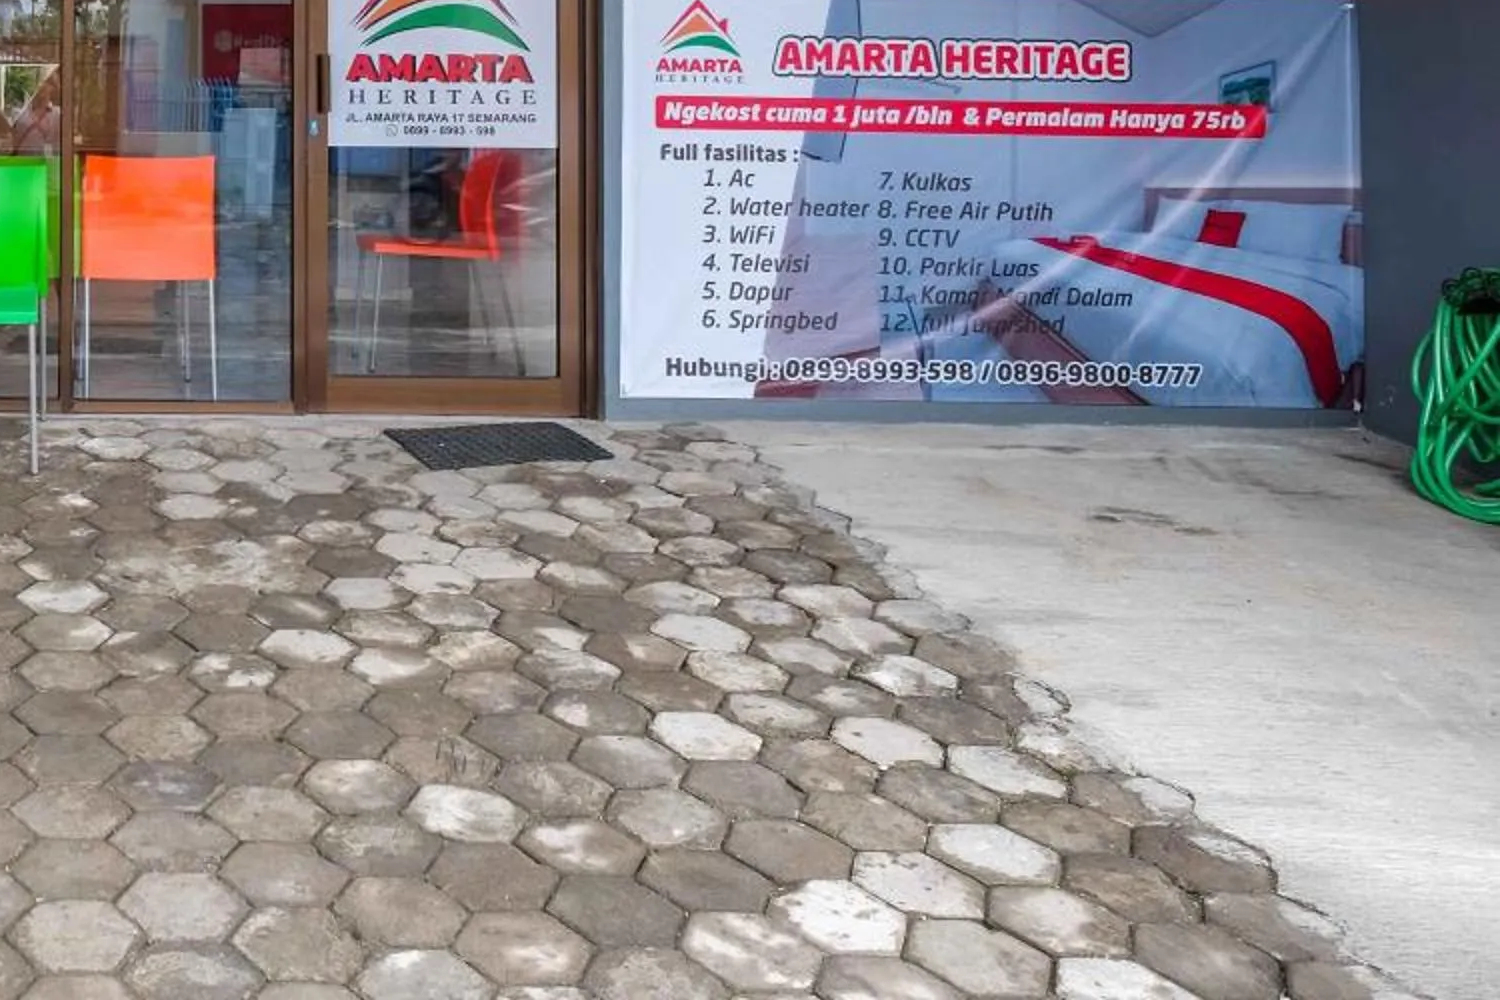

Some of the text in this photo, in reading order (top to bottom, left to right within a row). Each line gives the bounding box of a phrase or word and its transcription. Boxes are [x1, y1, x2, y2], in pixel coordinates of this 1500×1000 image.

[345, 54, 534, 83] AMARTA
[656, 58, 743, 73] AMARTA
[776, 39, 1129, 78] AMARTA HERITAGE
[656, 74, 744, 83] HERITAGE
[350, 89, 537, 105] HERITAGE
[345, 114, 537, 124] JL. AMARTA RAYA 17 SEMARANG
[663, 101, 1245, 132] Ngekost cuma 1 juta /bln & Permalam Hanya 75rb
[660, 144, 697, 161] Full
[705, 144, 787, 162] fasilitas
[703, 169, 756, 187] 1. Ac
[878, 171, 973, 192] 7. Kulkas
[703, 197, 870, 218] 2. Water heater
[877, 199, 1053, 222] 8. Free Air Putih
[702, 225, 776, 244] 3. WiFi
[878, 229, 960, 248] 9. CCTV
[702, 253, 810, 273] 4. Televisi
[877, 256, 1041, 278] 10. Parkir Luas
[701, 281, 793, 304] 5. Dapur
[1066, 287, 1133, 307] Dalam
[701, 310, 838, 334] 6. Springbed
[879, 313, 912, 332] 12.
[665, 358, 765, 381] Hubungi
[785, 359, 974, 381] 0899-8993-598
[980, 361, 991, 382] /
[998, 360, 1201, 385] 0896-9800-8777
